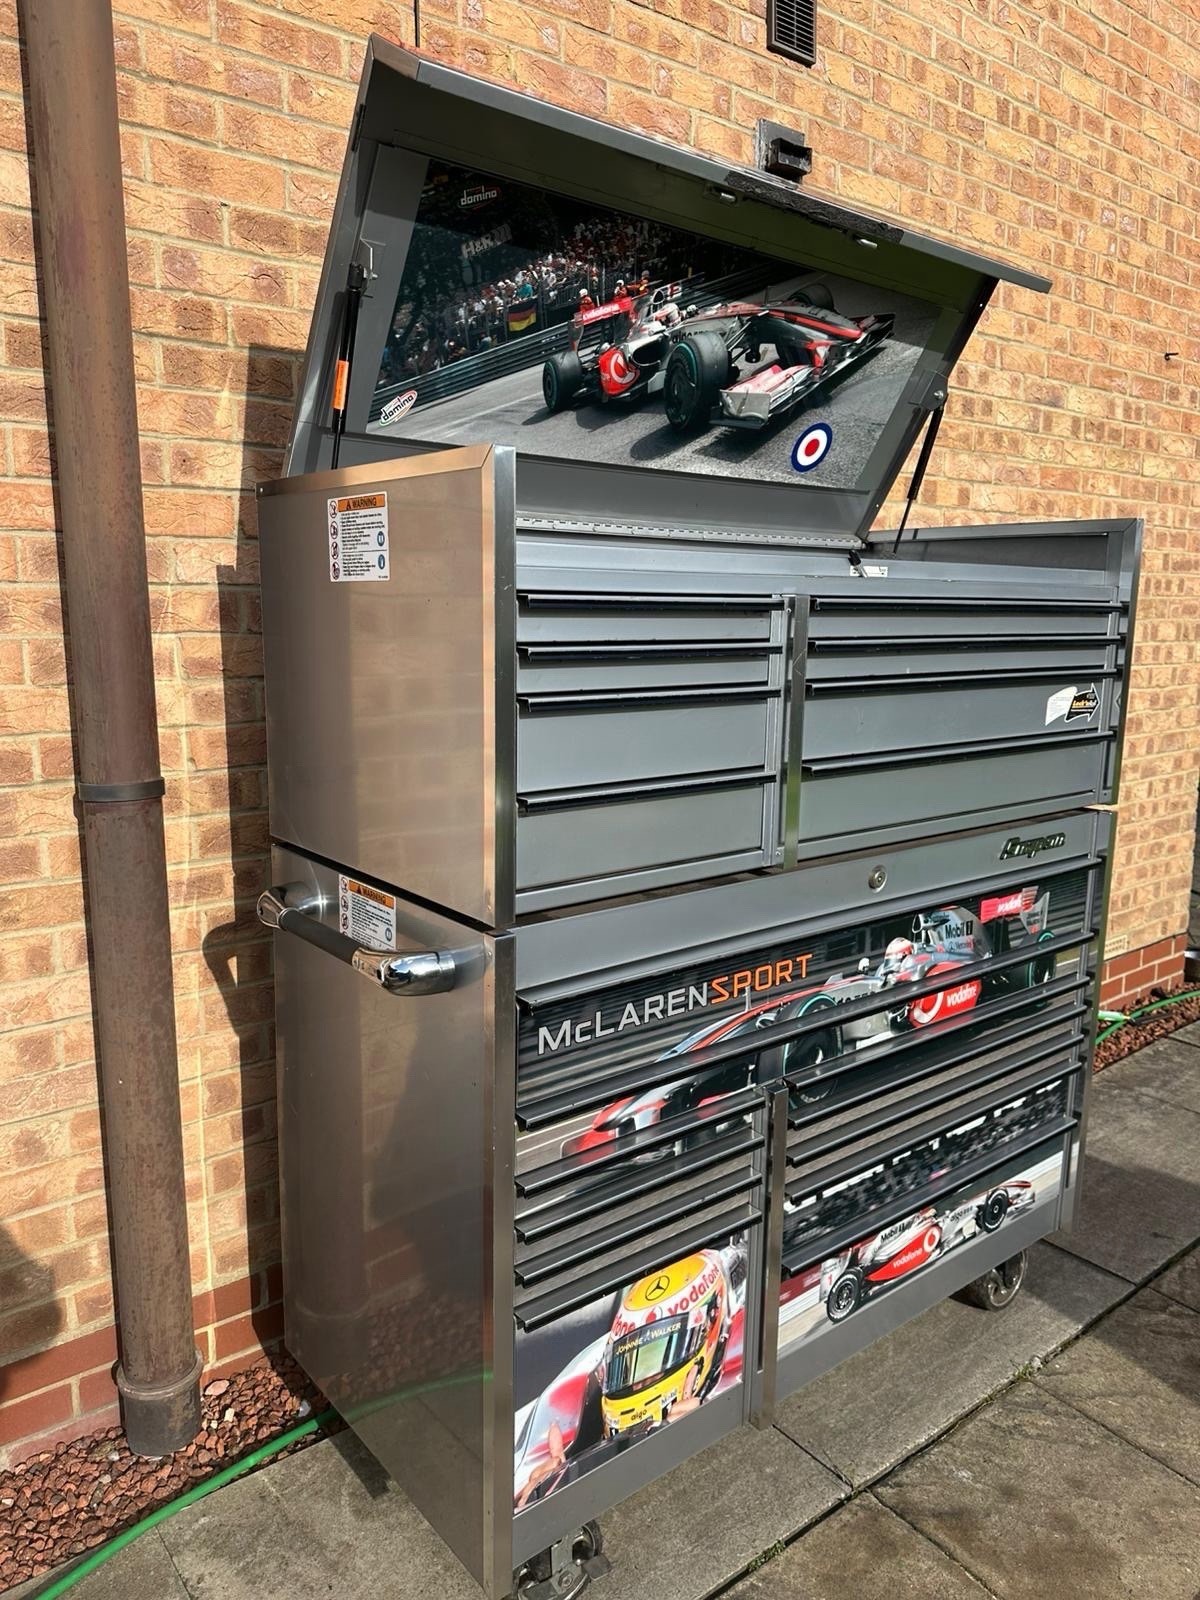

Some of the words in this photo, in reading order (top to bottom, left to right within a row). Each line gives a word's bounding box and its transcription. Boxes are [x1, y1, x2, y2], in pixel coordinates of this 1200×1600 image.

[460, 185, 498, 206] domino
[382, 395, 414, 421] domino
[944, 921, 965, 940] Mobil
[650, 1321, 681, 1339] WALKER
[630, 1408, 648, 1422] aigo
